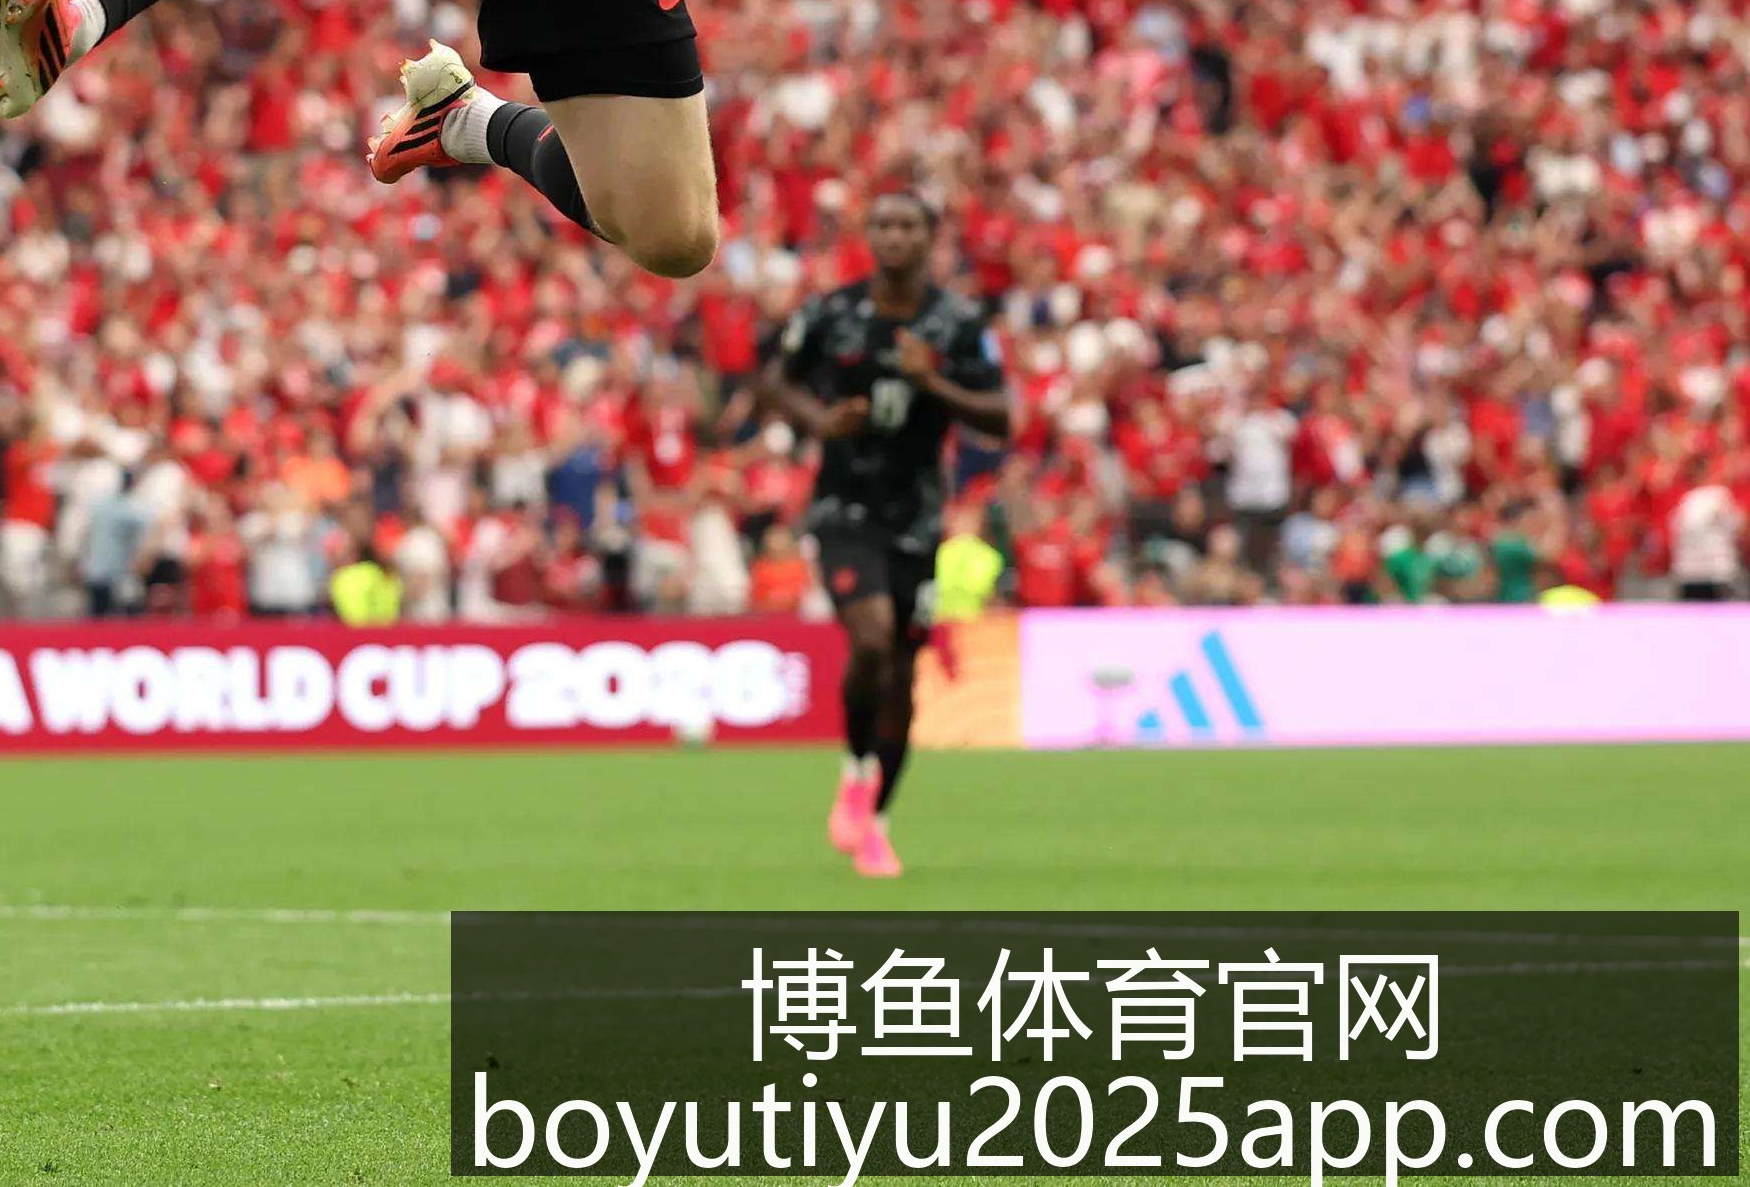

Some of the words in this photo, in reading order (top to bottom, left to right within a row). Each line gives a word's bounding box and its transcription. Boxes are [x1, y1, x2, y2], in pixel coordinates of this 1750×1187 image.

[29, 645, 335, 734] WORLD
[336, 643, 504, 732] CUP
[505, 640, 788, 728] 2026
